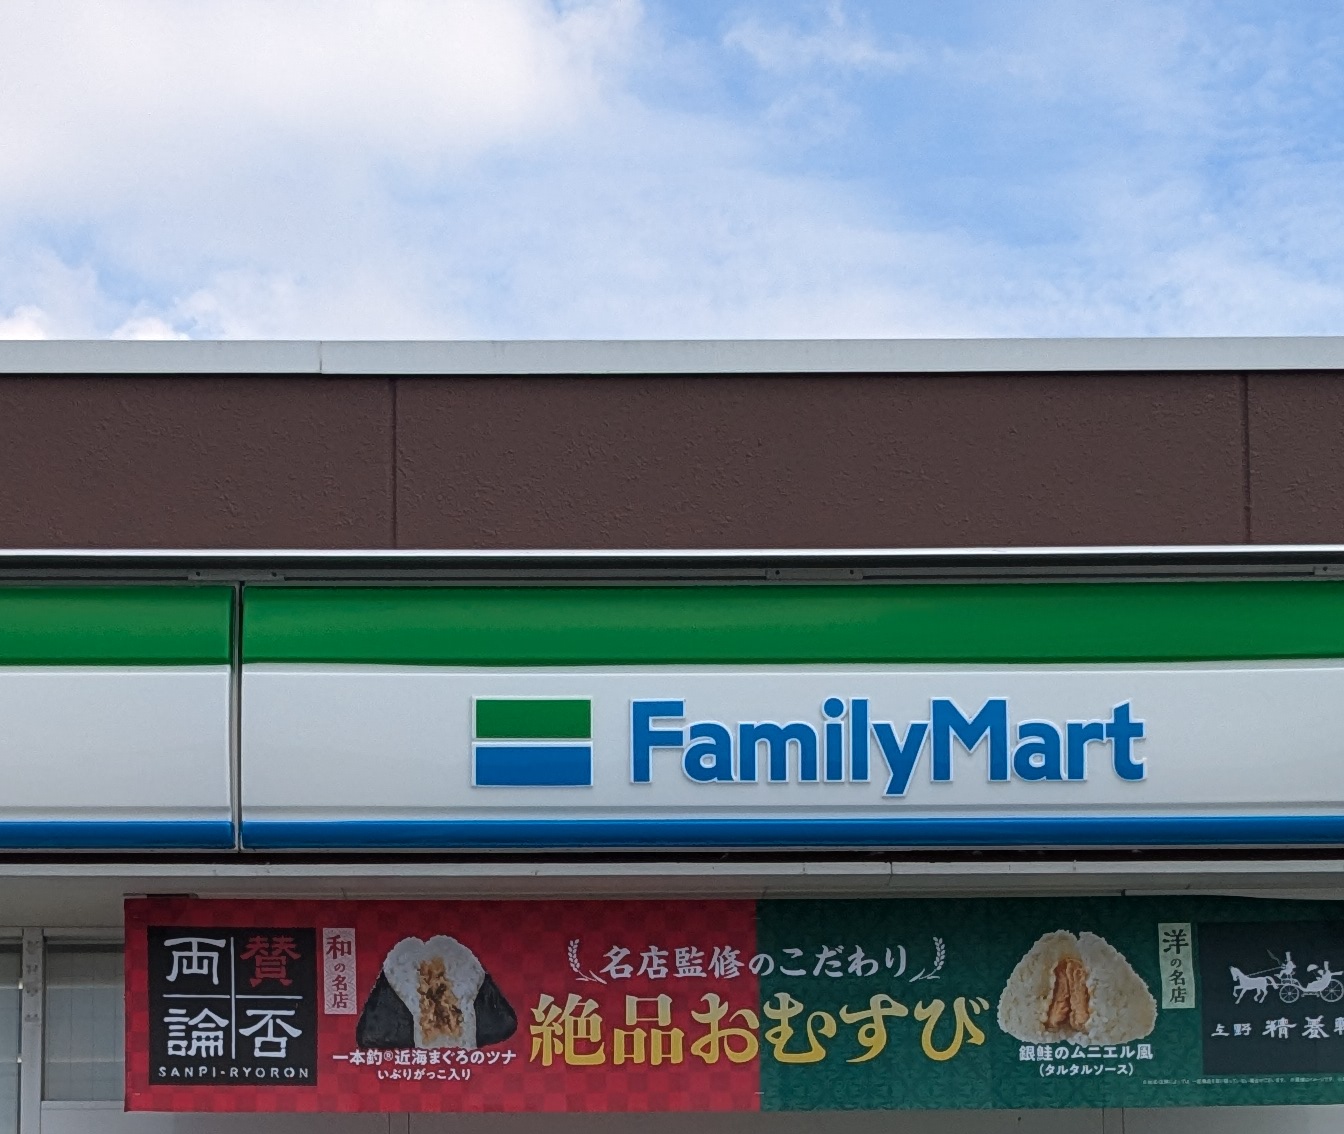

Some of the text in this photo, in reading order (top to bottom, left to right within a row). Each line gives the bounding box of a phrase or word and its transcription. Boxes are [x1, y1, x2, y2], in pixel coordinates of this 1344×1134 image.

[630, 697, 1146, 797] FamilyMart
[326, 934, 353, 1010] 和の名店
[601, 944, 908, 980] 名店監修のこだわり
[1162, 929, 1189, 1004] 洋の名店
[529, 991, 990, 1066] 絶品おむすび
[1019, 1044, 1154, 1062] 銀鮭のムニエル風
[158, 1066, 310, 1080] SANPI-RYORON
[377, 1068, 472, 1081] いぶりがっこ入り
